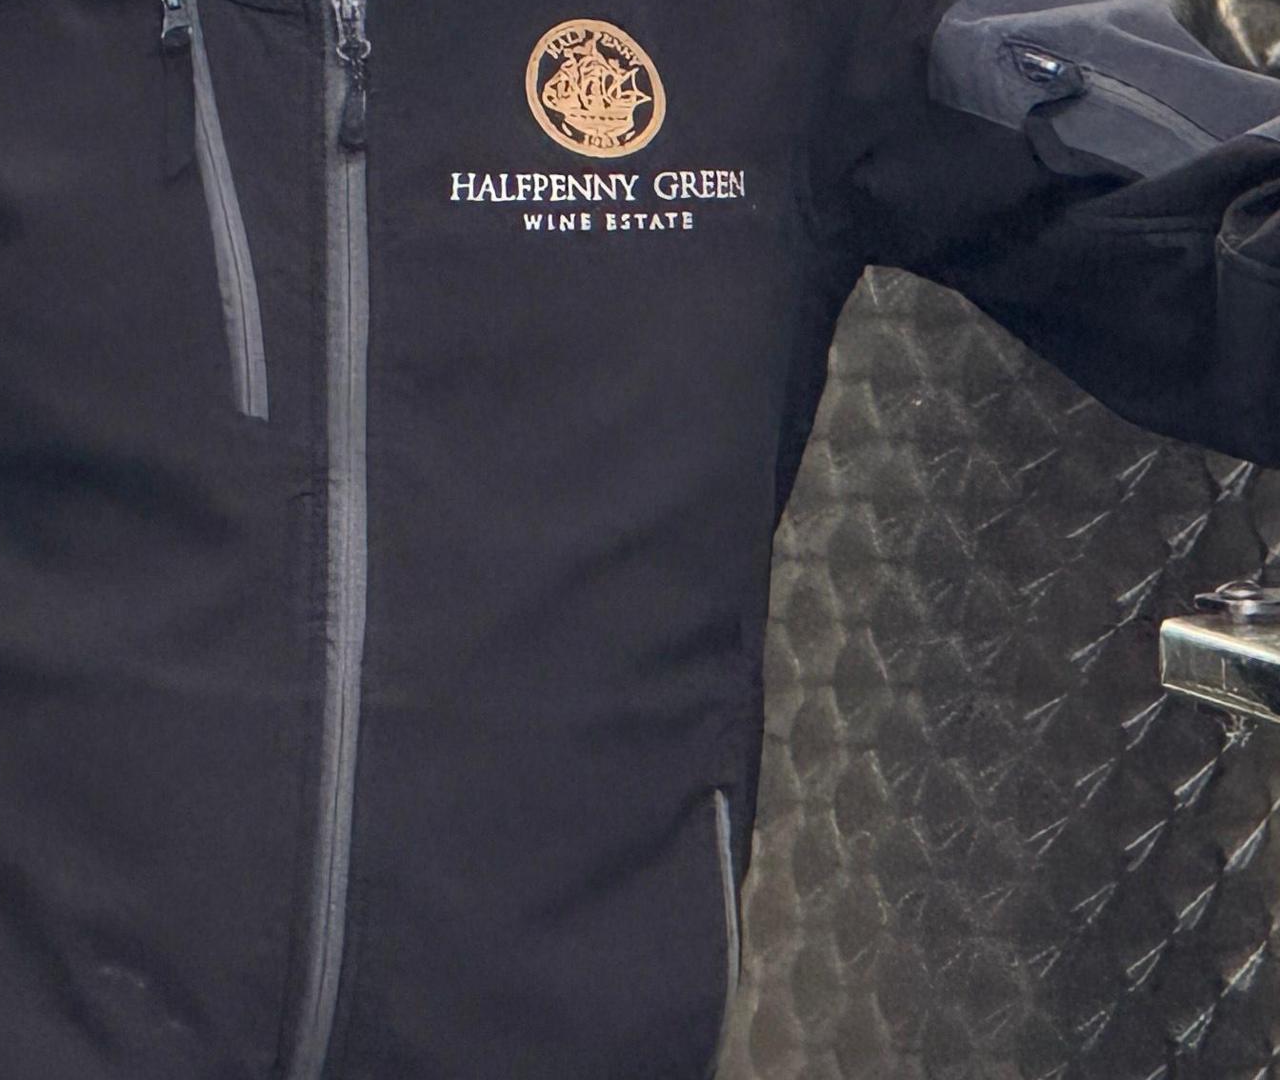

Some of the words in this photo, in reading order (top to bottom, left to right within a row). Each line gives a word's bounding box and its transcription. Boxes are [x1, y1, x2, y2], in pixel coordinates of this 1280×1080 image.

[450, 172, 639, 202] HALFPENNY
[653, 170, 745, 200] GREEN
[523, 212, 592, 231] WINE
[606, 211, 694, 231] ESTATE
